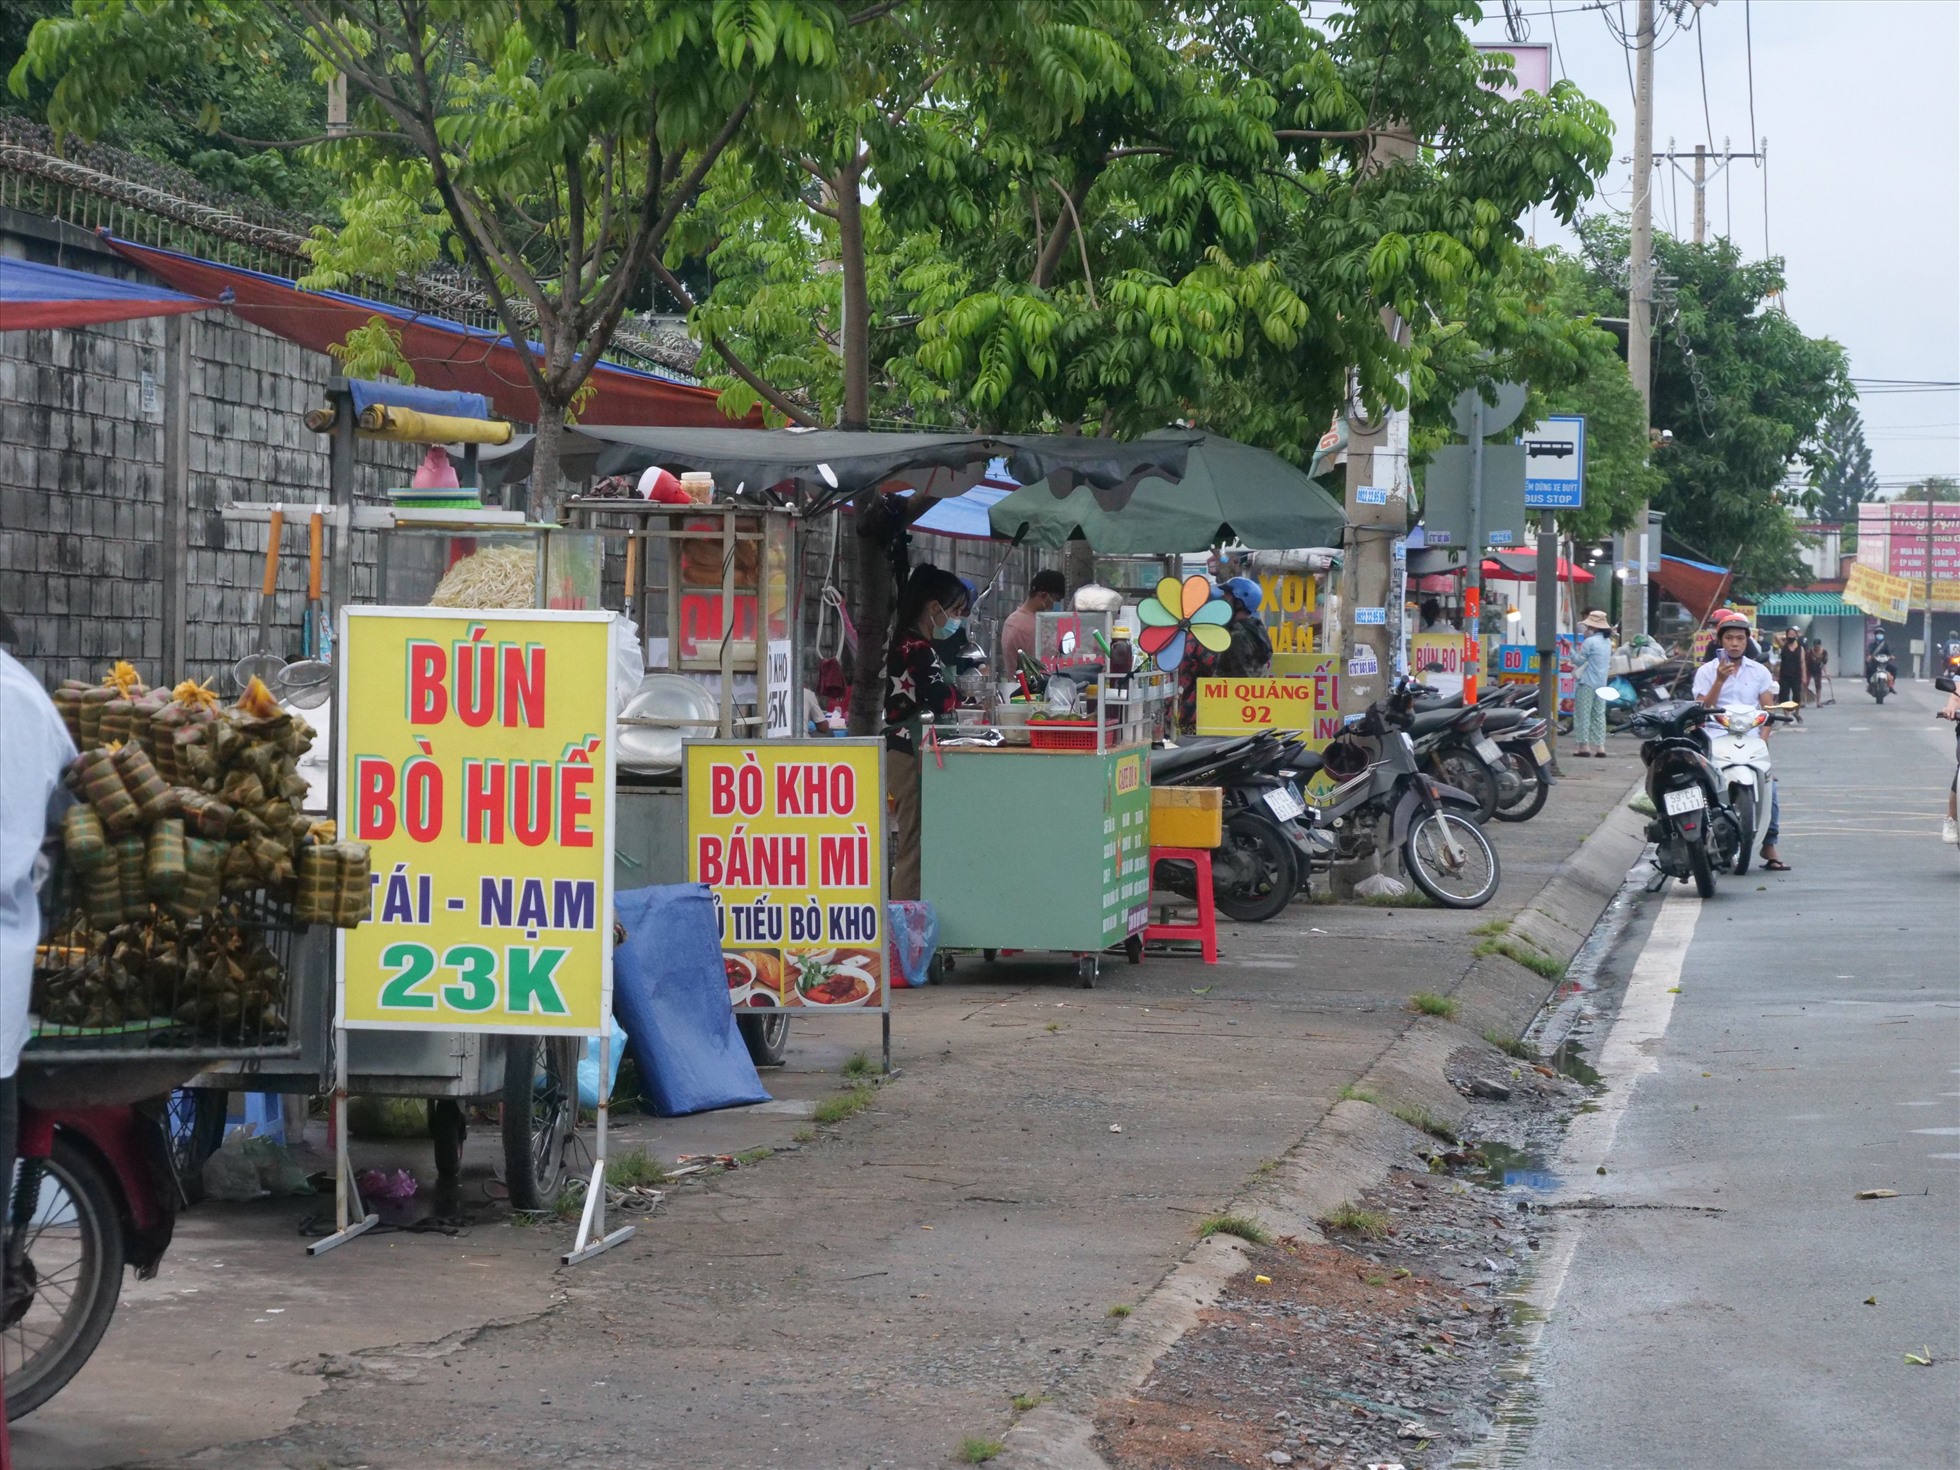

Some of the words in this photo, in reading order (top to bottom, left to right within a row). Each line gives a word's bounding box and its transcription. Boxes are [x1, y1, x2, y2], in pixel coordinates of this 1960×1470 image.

[1525, 494, 1544, 503] BUS
[1546, 494, 1572, 504] STOP
[1553, 483, 1561, 492] XE
[405, 622, 546, 728] BÚN
[774, 652, 787, 683] KHO
[1442, 642, 1456, 672] BÒ
[1205, 680, 1228, 698] MÌ
[1234, 680, 1309, 702] QUẢNG
[1242, 706, 1272, 723] 92
[354, 734, 444, 842] BÒ
[461, 734, 602, 847] HUẾ
[711, 750, 764, 817] BÒ
[775, 763, 856, 817] KHO
[698, 823, 808, 888] BÁNH
[818, 823, 871, 888] MÌ
[480, 877, 596, 940] NẠM
[731, 893, 784, 943] TIẾU
[789, 895, 822, 943] BÒ
[828, 904, 877, 944] KHO
[379, 942, 572, 1016] 23K
